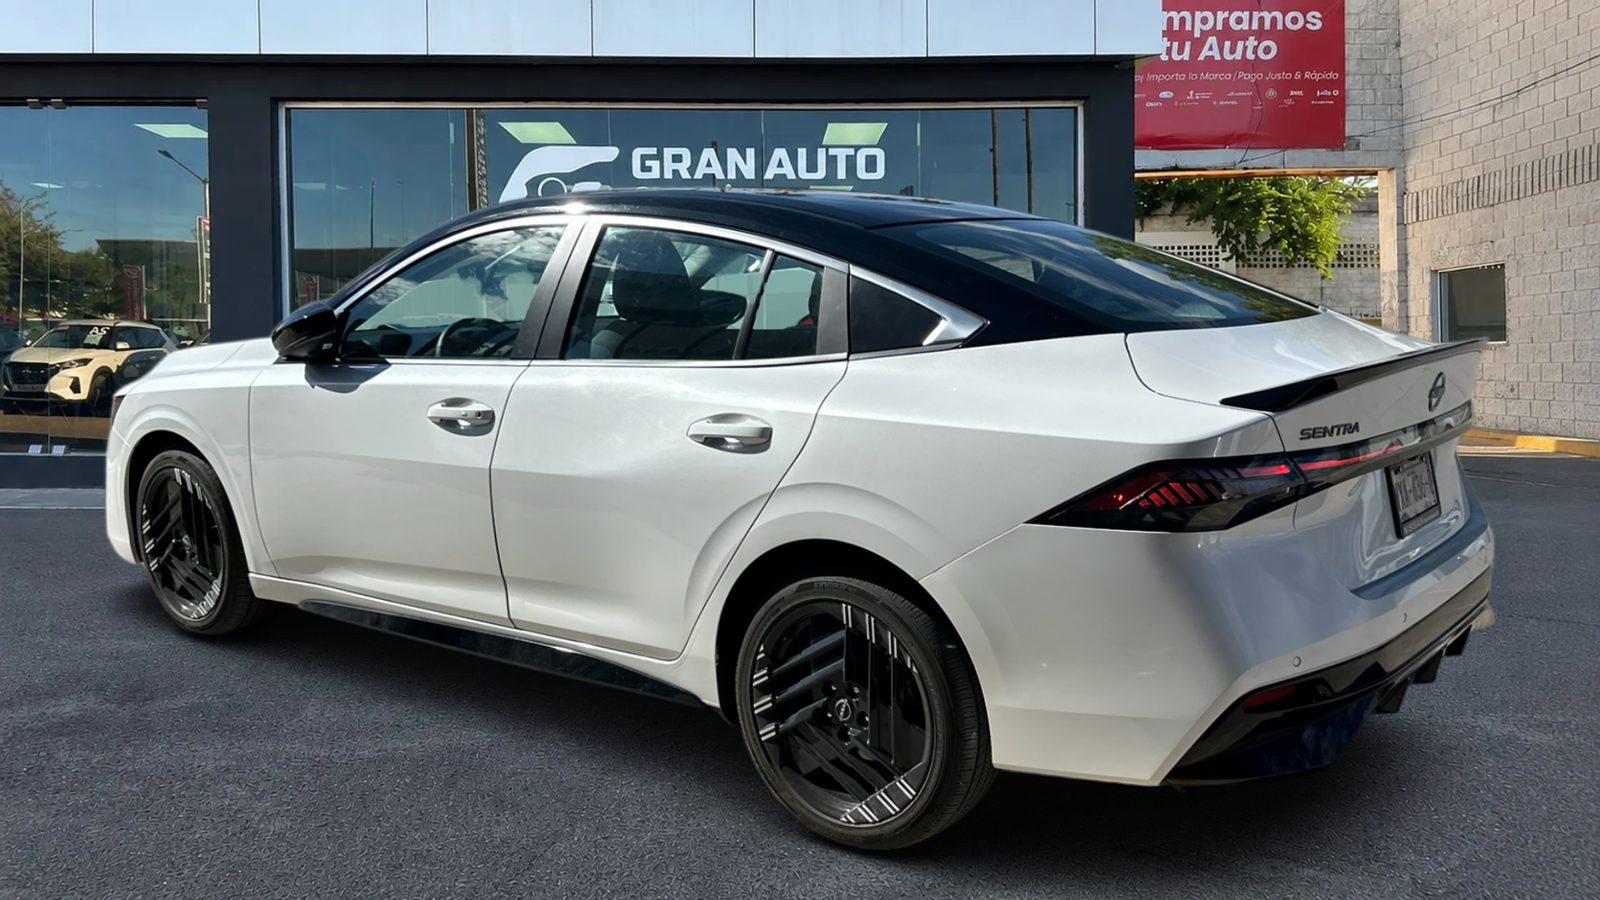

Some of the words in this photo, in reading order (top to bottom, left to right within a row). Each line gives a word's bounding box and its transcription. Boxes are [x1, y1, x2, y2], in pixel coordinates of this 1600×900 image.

[1160, 37, 1191, 61] tu
[1198, 36, 1278, 61] Auto
[1146, 72, 1186, 83] Importa
[1188, 71, 1198, 81] la
[1199, 72, 1232, 81] Marca
[1265, 72, 1292, 80] Justo
[1294, 72, 1301, 80] &
[632, 147, 755, 180] GRAN
[763, 147, 886, 180] AUTO
[1299, 421, 1360, 441] SENTRA
